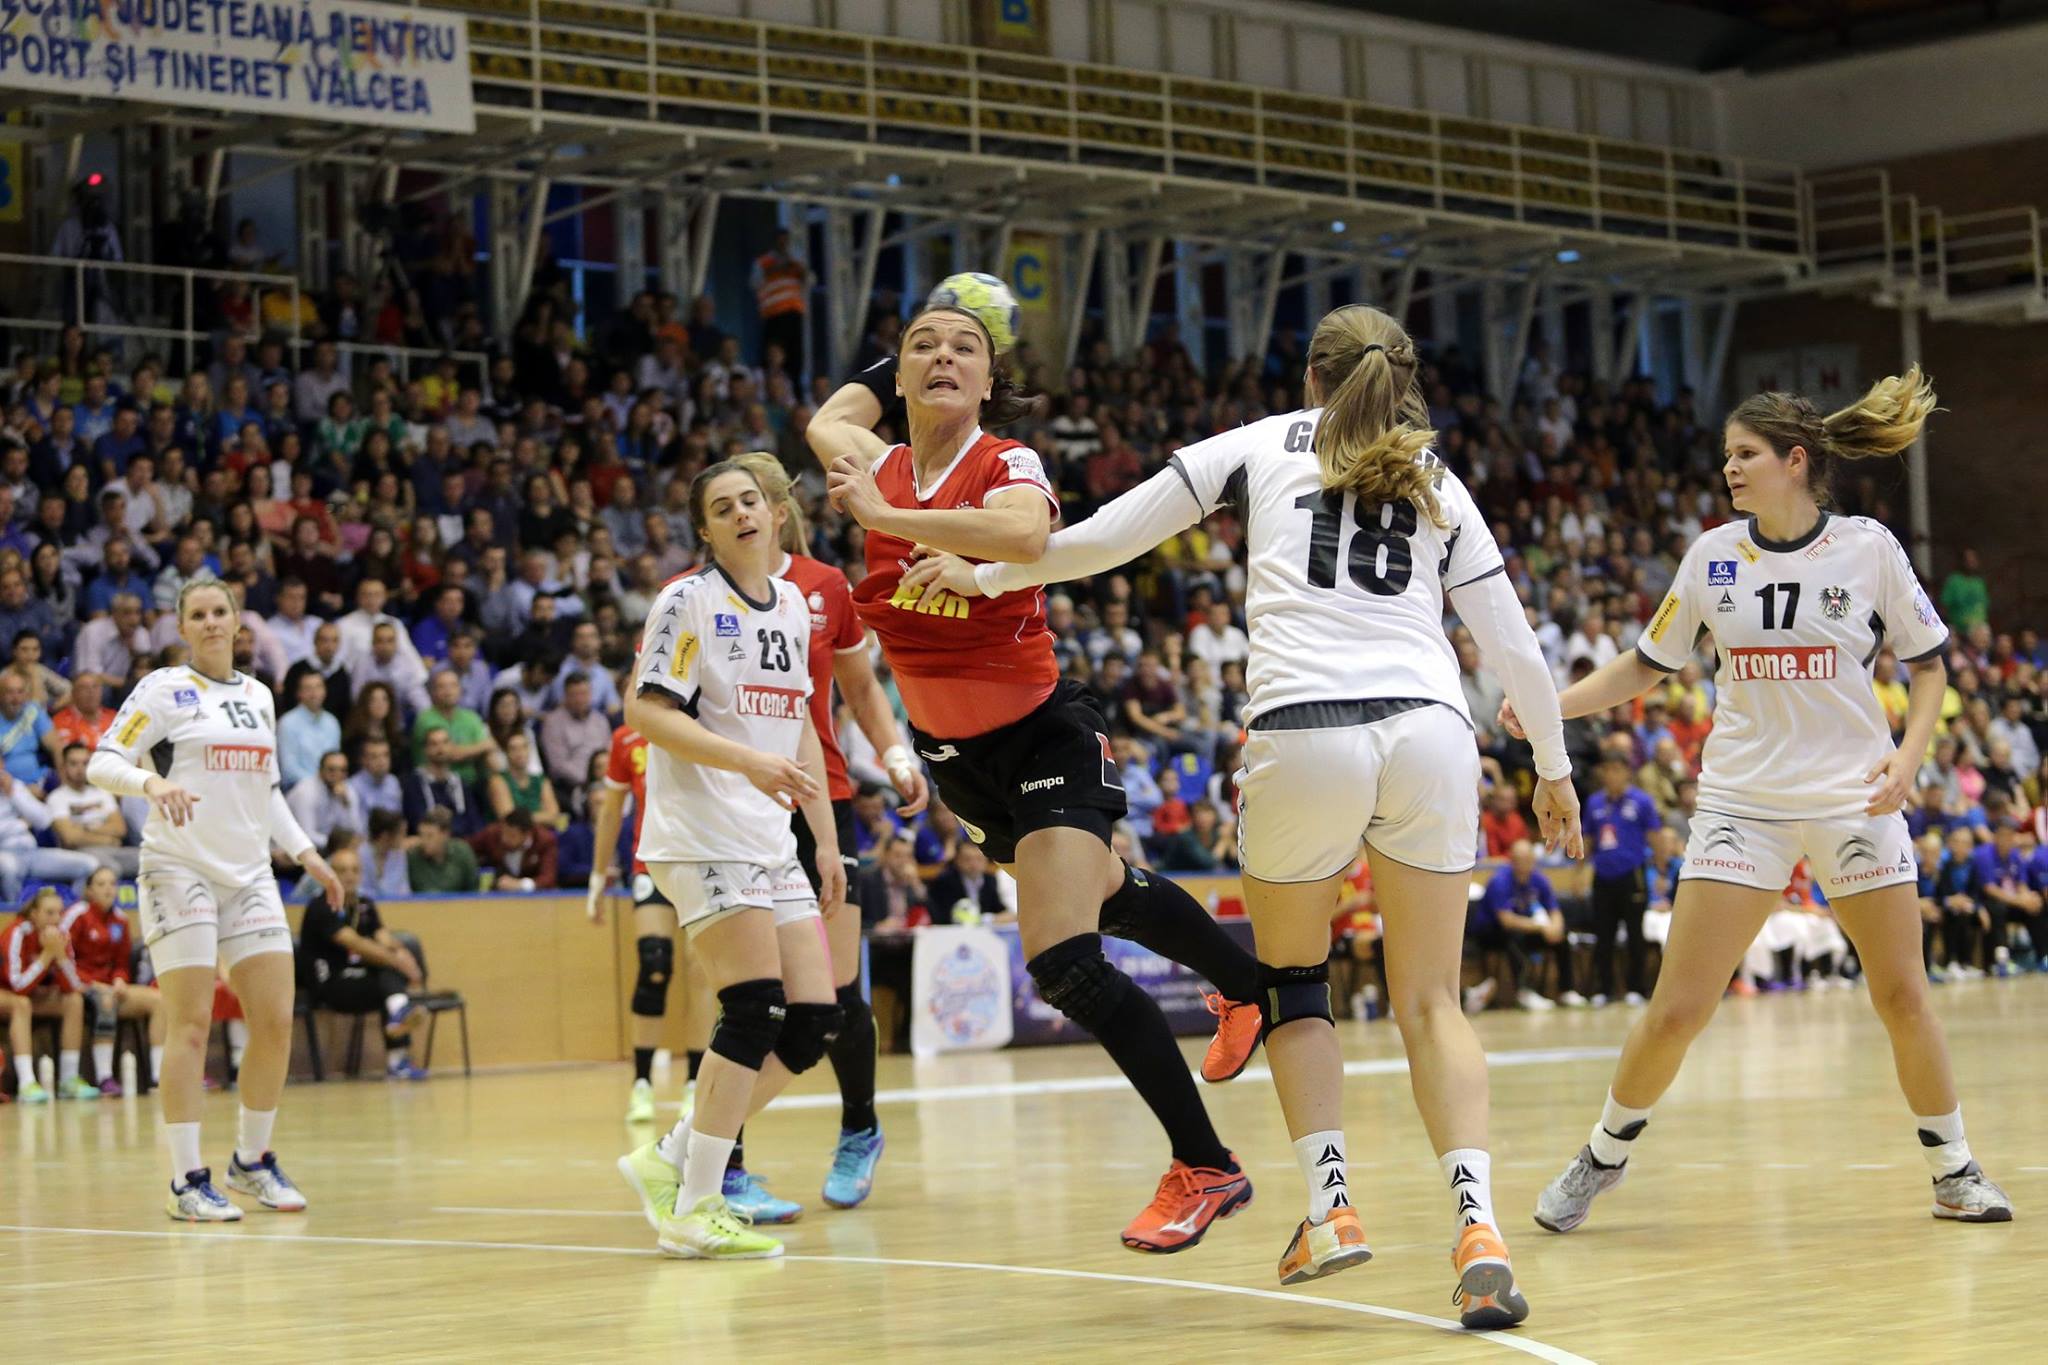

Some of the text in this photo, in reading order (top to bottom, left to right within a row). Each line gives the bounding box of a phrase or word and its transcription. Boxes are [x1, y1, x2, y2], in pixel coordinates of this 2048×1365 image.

[329, 11, 456, 62] PENTRU
[148, 47, 291, 99] TINERET
[1013, 254, 1044, 299] C
[1294, 488, 1417, 596] 18
[1754, 582, 1801, 630] 17
[757, 628, 791, 673] 23
[1727, 647, 1836, 682] krone.at
[219, 701, 258, 729] 15
[1020, 776, 1065, 795] Kempa
